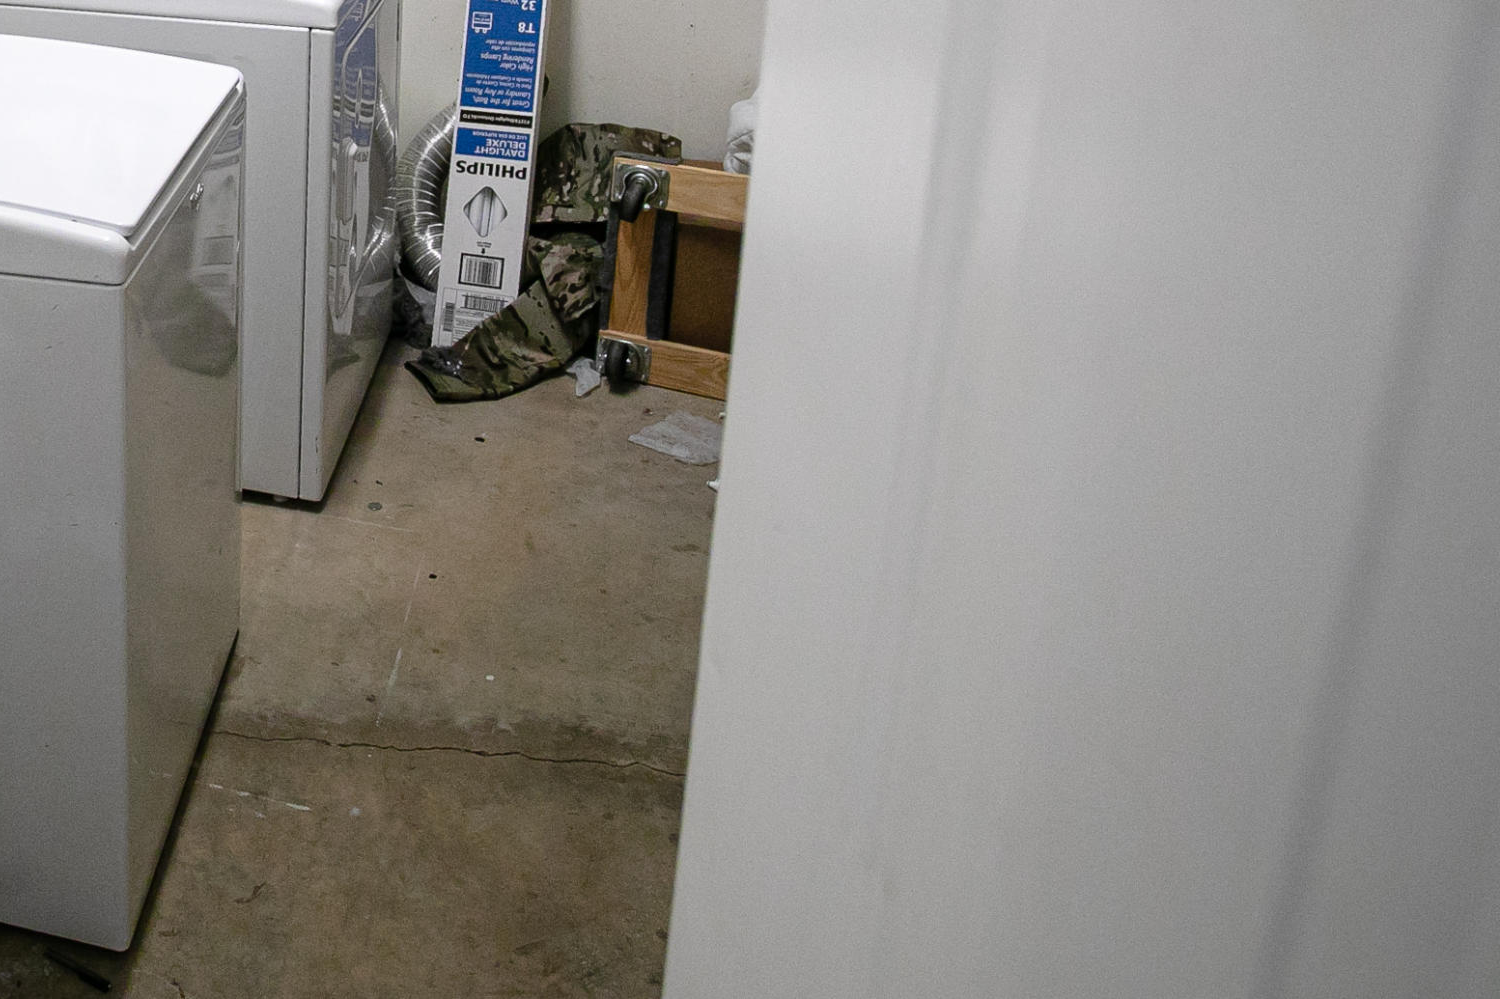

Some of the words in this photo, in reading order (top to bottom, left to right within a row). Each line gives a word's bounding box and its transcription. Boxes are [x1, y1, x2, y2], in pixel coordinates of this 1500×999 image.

[521, 0, 536, 10] 32
[518, 22, 535, 33] T8
[505, 89, 530, 99] Laundry
[512, 100, 529, 108] Great
[485, 138, 526, 149] DELUXE
[474, 145, 525, 157] DAYLIGHT
[456, 160, 527, 179] PHILIPS
